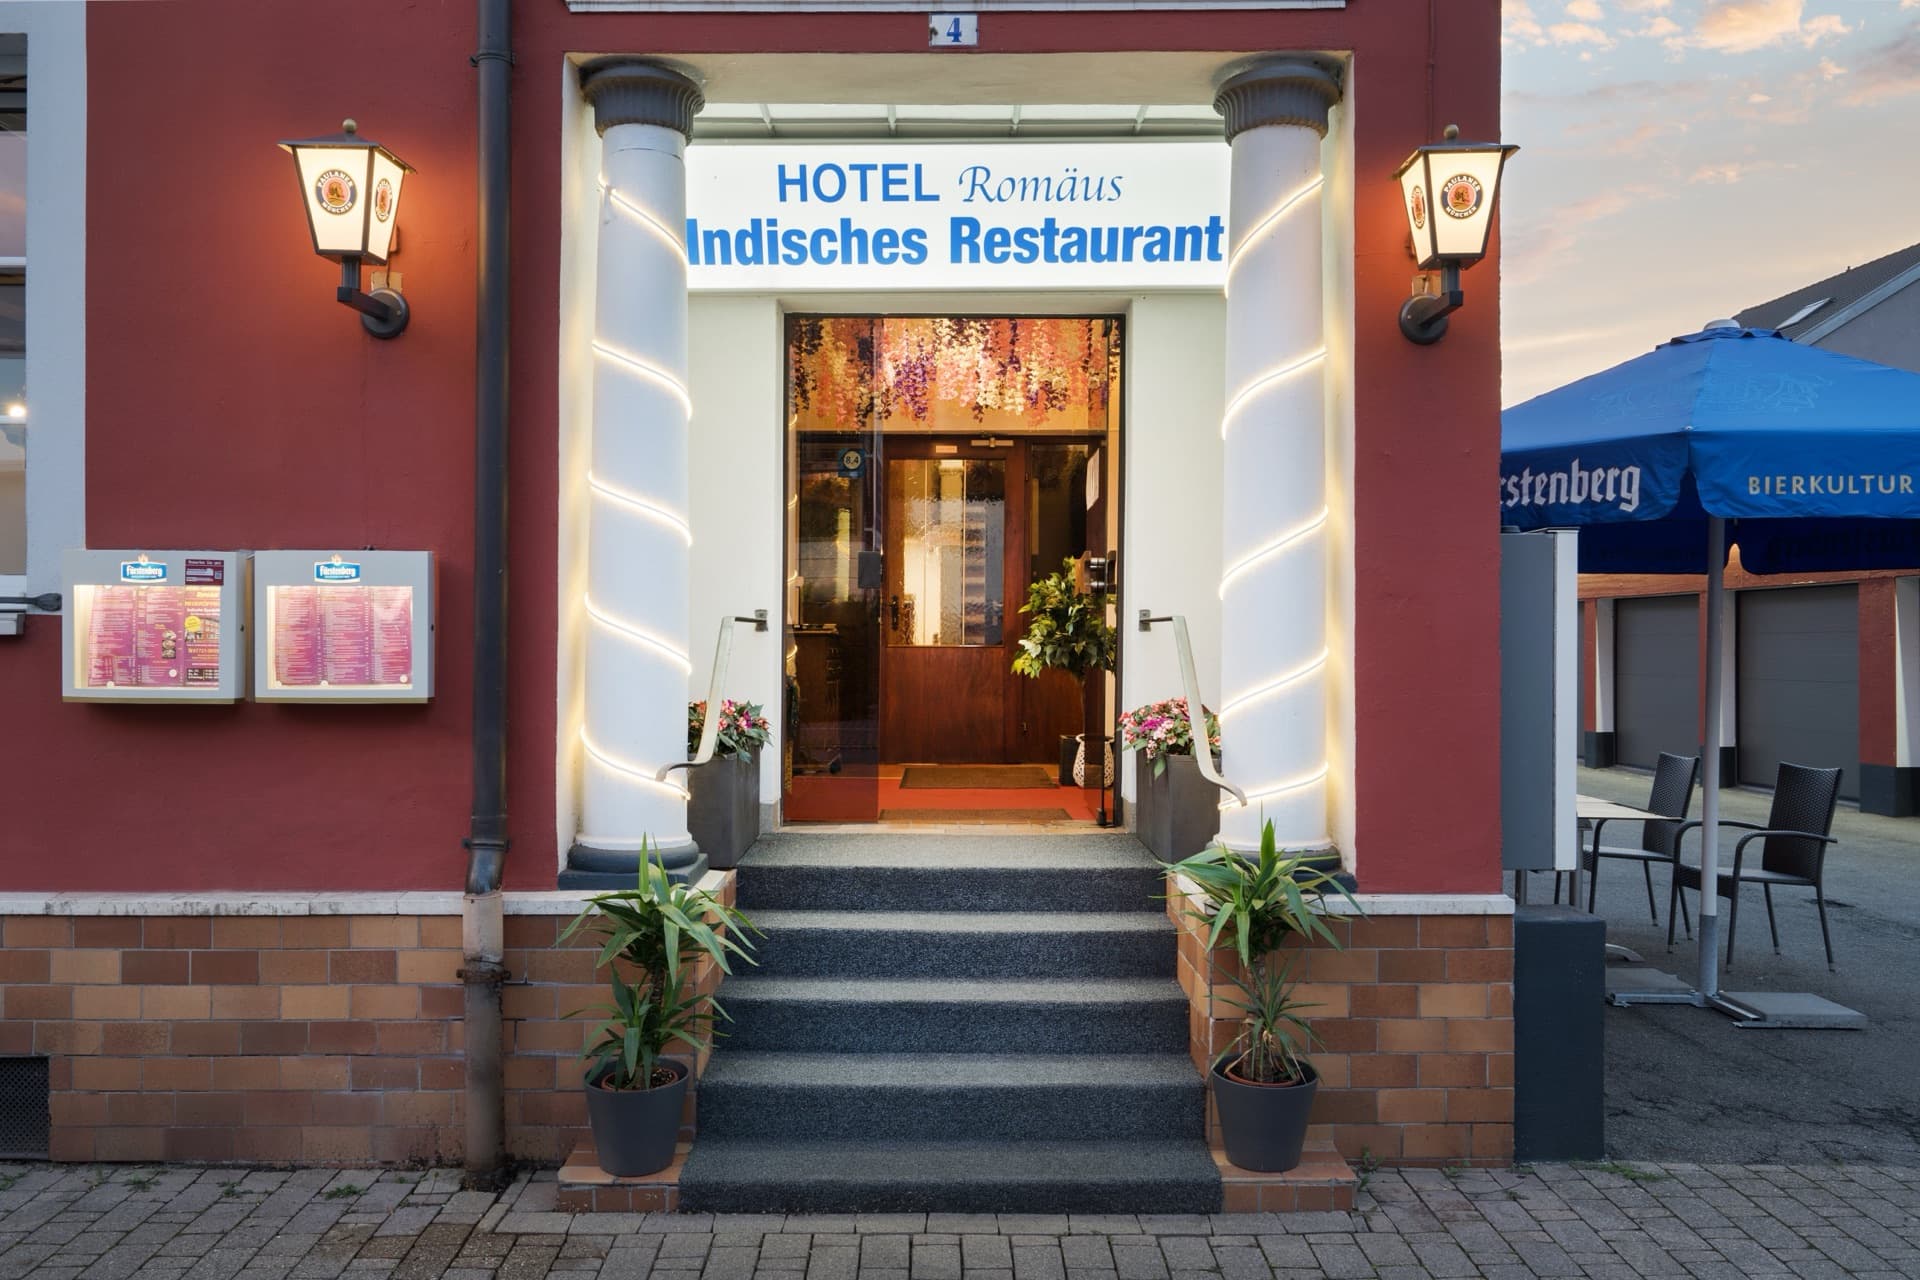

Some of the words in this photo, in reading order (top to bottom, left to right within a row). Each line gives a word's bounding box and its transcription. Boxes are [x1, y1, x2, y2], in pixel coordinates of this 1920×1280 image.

[946, 17, 962, 43] 4
[777, 163, 940, 202] HOTEL
[959, 166, 1123, 203] Romäus
[1443, 175, 1481, 192] PAULANER
[686, 217, 928, 266] Indisches
[950, 215, 1225, 264] Restaurant
[1748, 475, 1914, 495] BIERKULTUR
